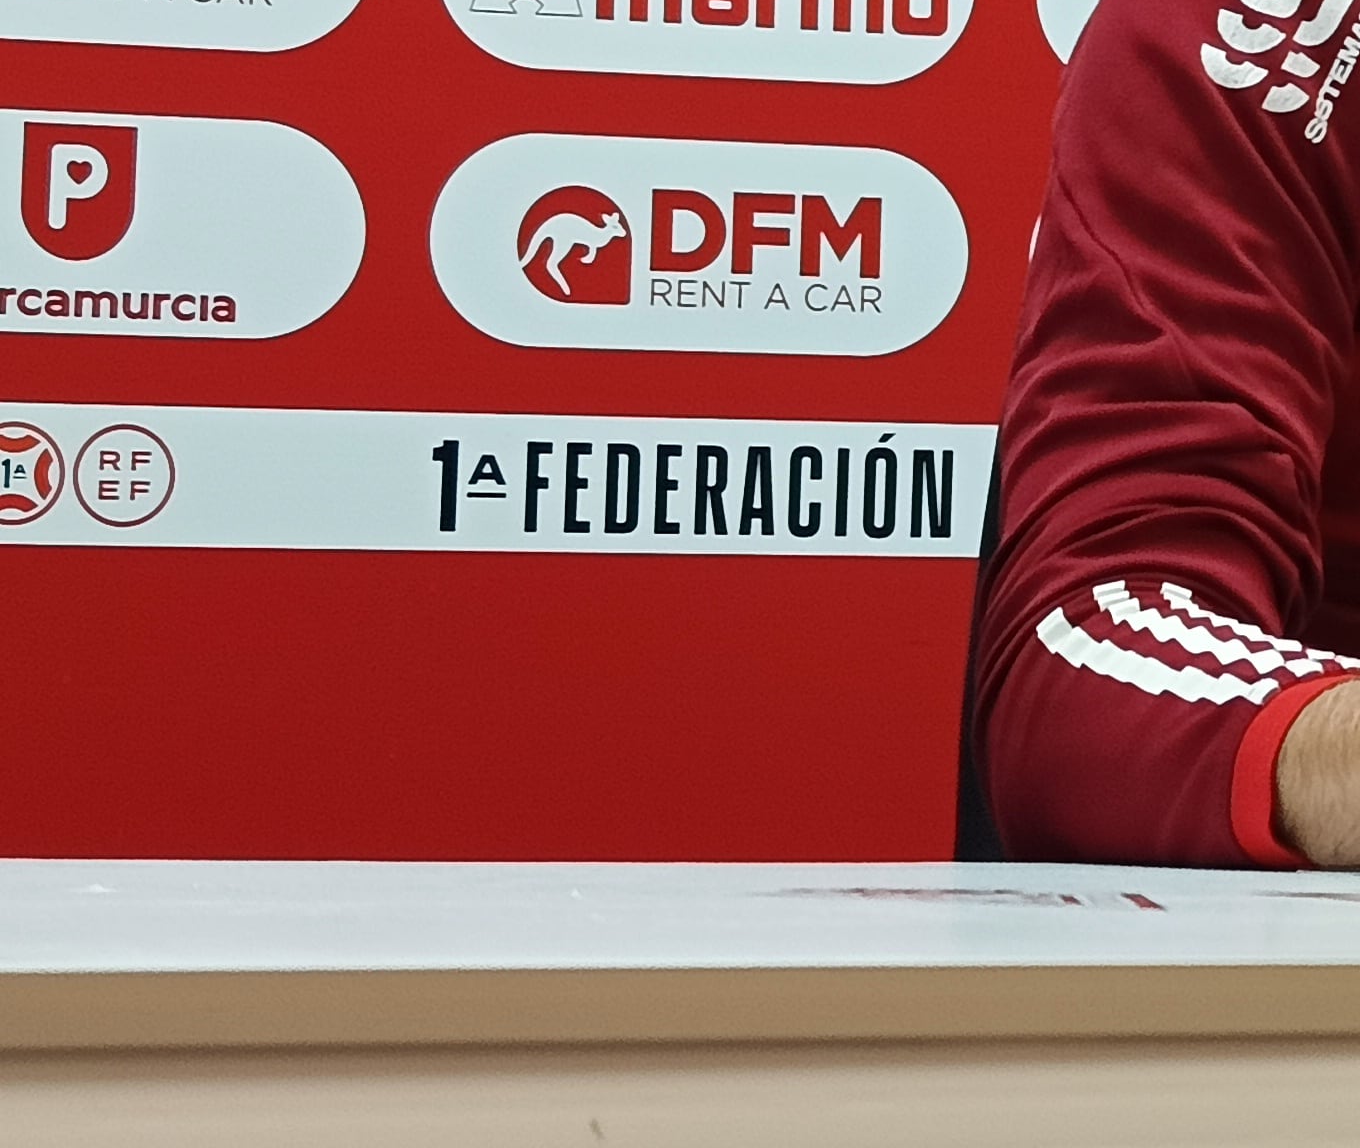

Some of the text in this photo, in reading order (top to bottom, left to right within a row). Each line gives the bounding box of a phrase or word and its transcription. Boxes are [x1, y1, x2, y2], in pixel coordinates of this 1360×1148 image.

[650, 189, 883, 279] DFM
[650, 279, 883, 315] RENT A CAR
